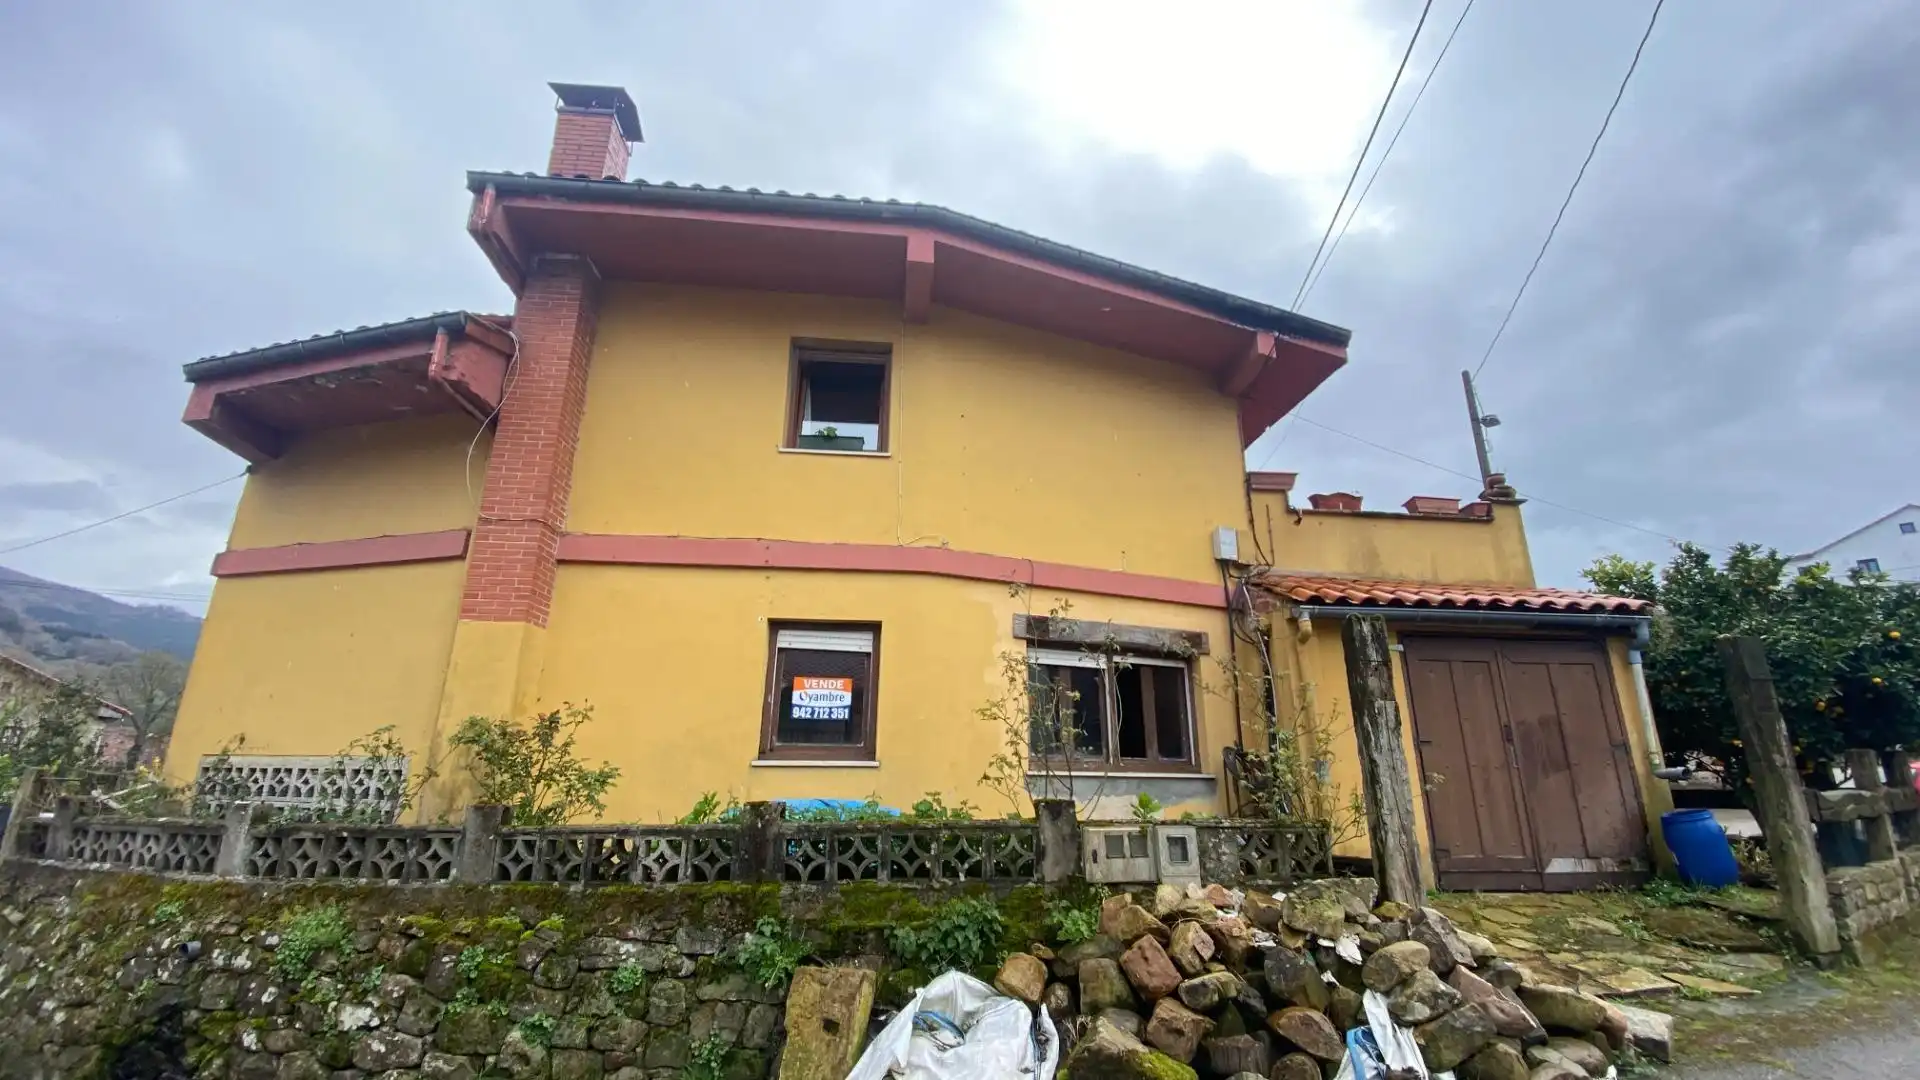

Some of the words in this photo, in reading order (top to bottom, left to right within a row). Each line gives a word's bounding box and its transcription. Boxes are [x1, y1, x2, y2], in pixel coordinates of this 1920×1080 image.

[803, 679, 845, 689] VENDE
[792, 707, 812, 718] 942
[813, 707, 830, 719] 712
[831, 707, 849, 719] 351
